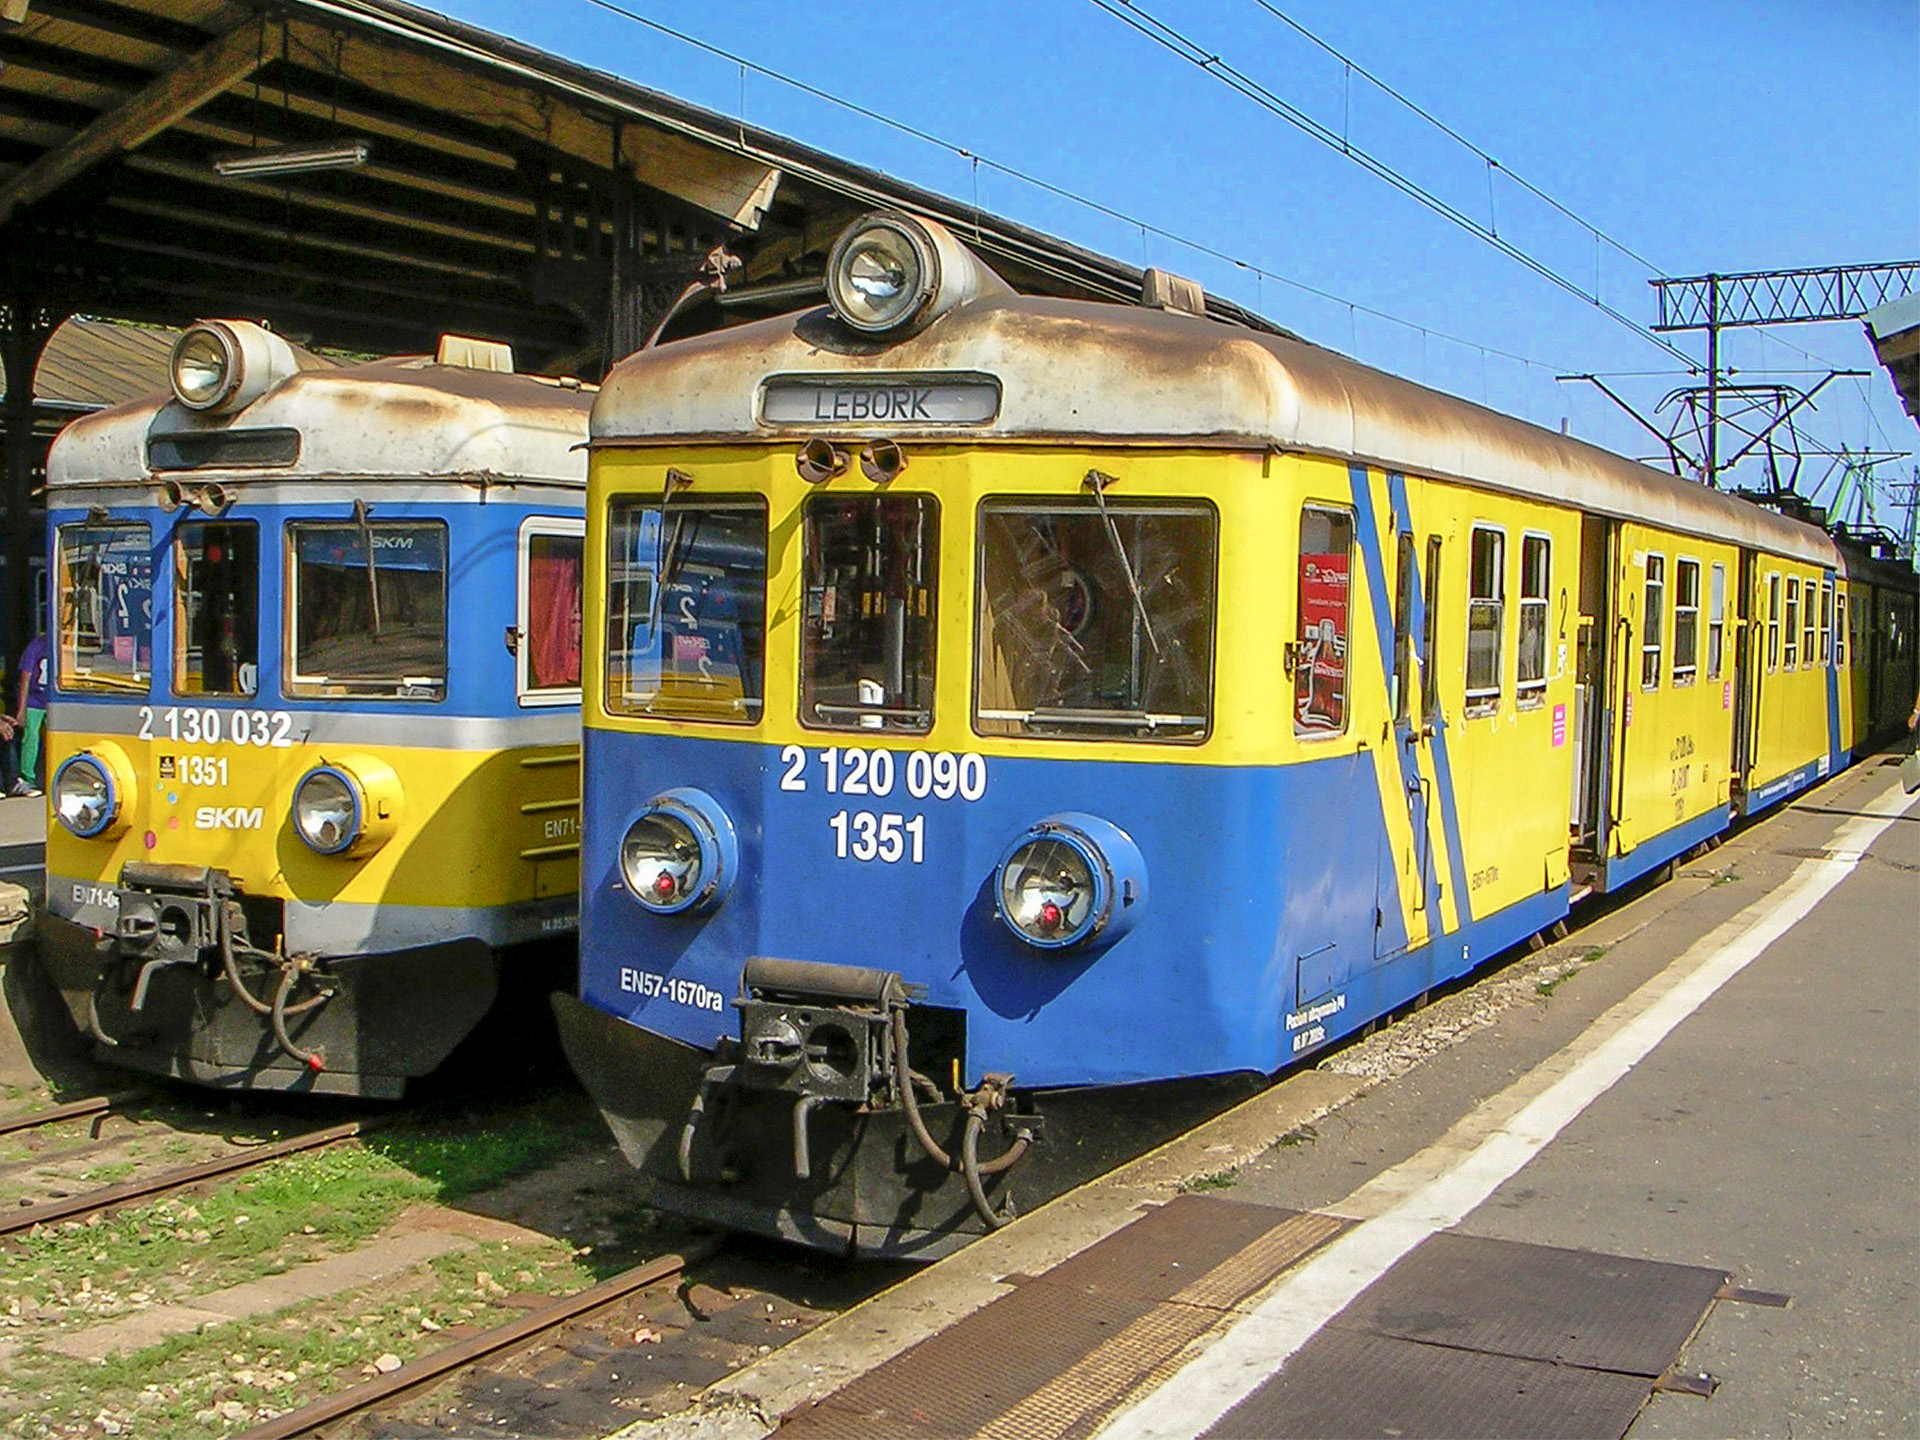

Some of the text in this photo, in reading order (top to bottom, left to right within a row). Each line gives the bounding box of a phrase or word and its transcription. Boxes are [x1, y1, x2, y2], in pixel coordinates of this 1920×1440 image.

[138, 706, 154, 741] 2
[165, 707, 221, 744] 130
[231, 709, 292, 747] 032
[178, 756, 228, 786] 1351
[780, 745, 987, 801] 2 120 090
[195, 807, 264, 829] SKM
[829, 810, 925, 863] 1351
[621, 967, 723, 1012] EN57-1670ra
